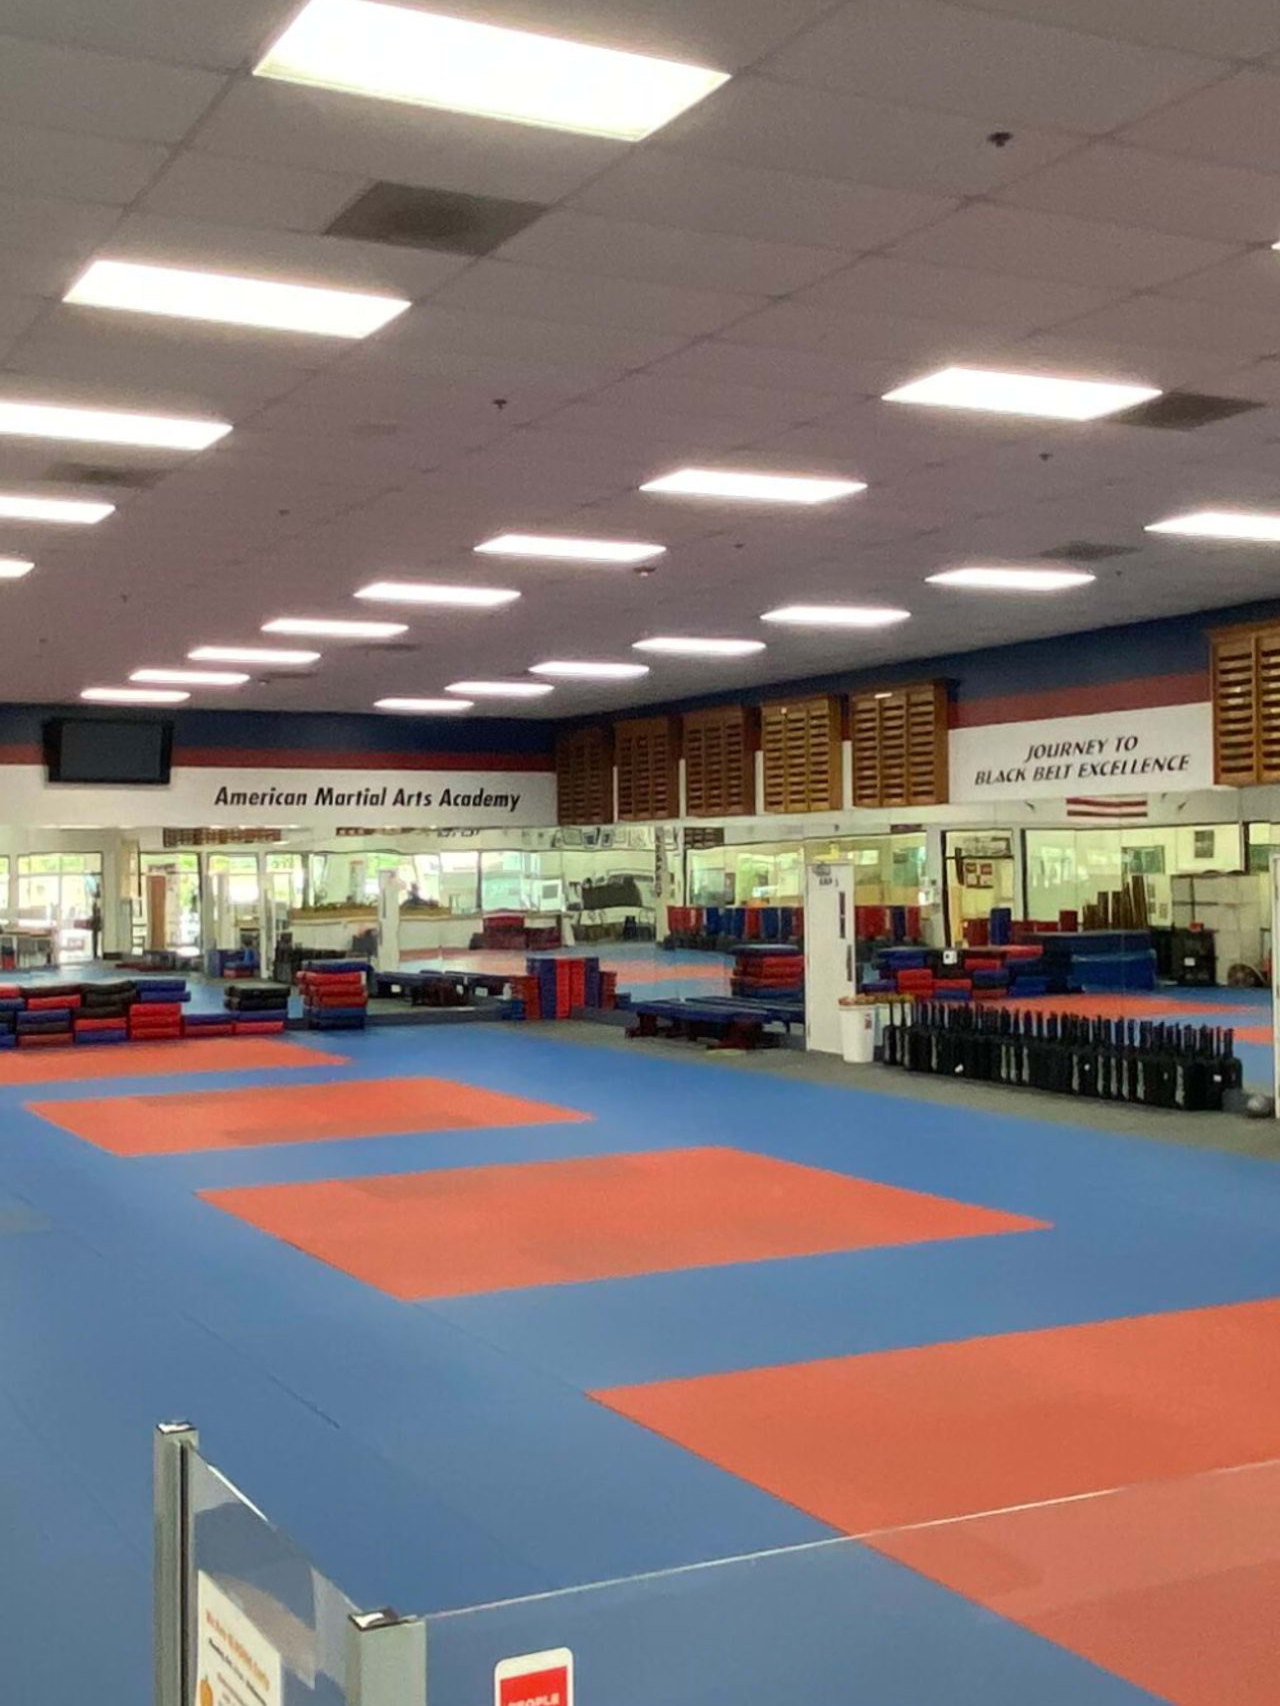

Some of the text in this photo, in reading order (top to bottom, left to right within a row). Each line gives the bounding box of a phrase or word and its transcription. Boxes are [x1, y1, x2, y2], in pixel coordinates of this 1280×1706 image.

[1024, 735, 1139, 763] JOURNEY TO
[974, 753, 1191, 785] BLACK BELT EXCELLENCE
[213, 785, 522, 812] American Martial Arts Academy
